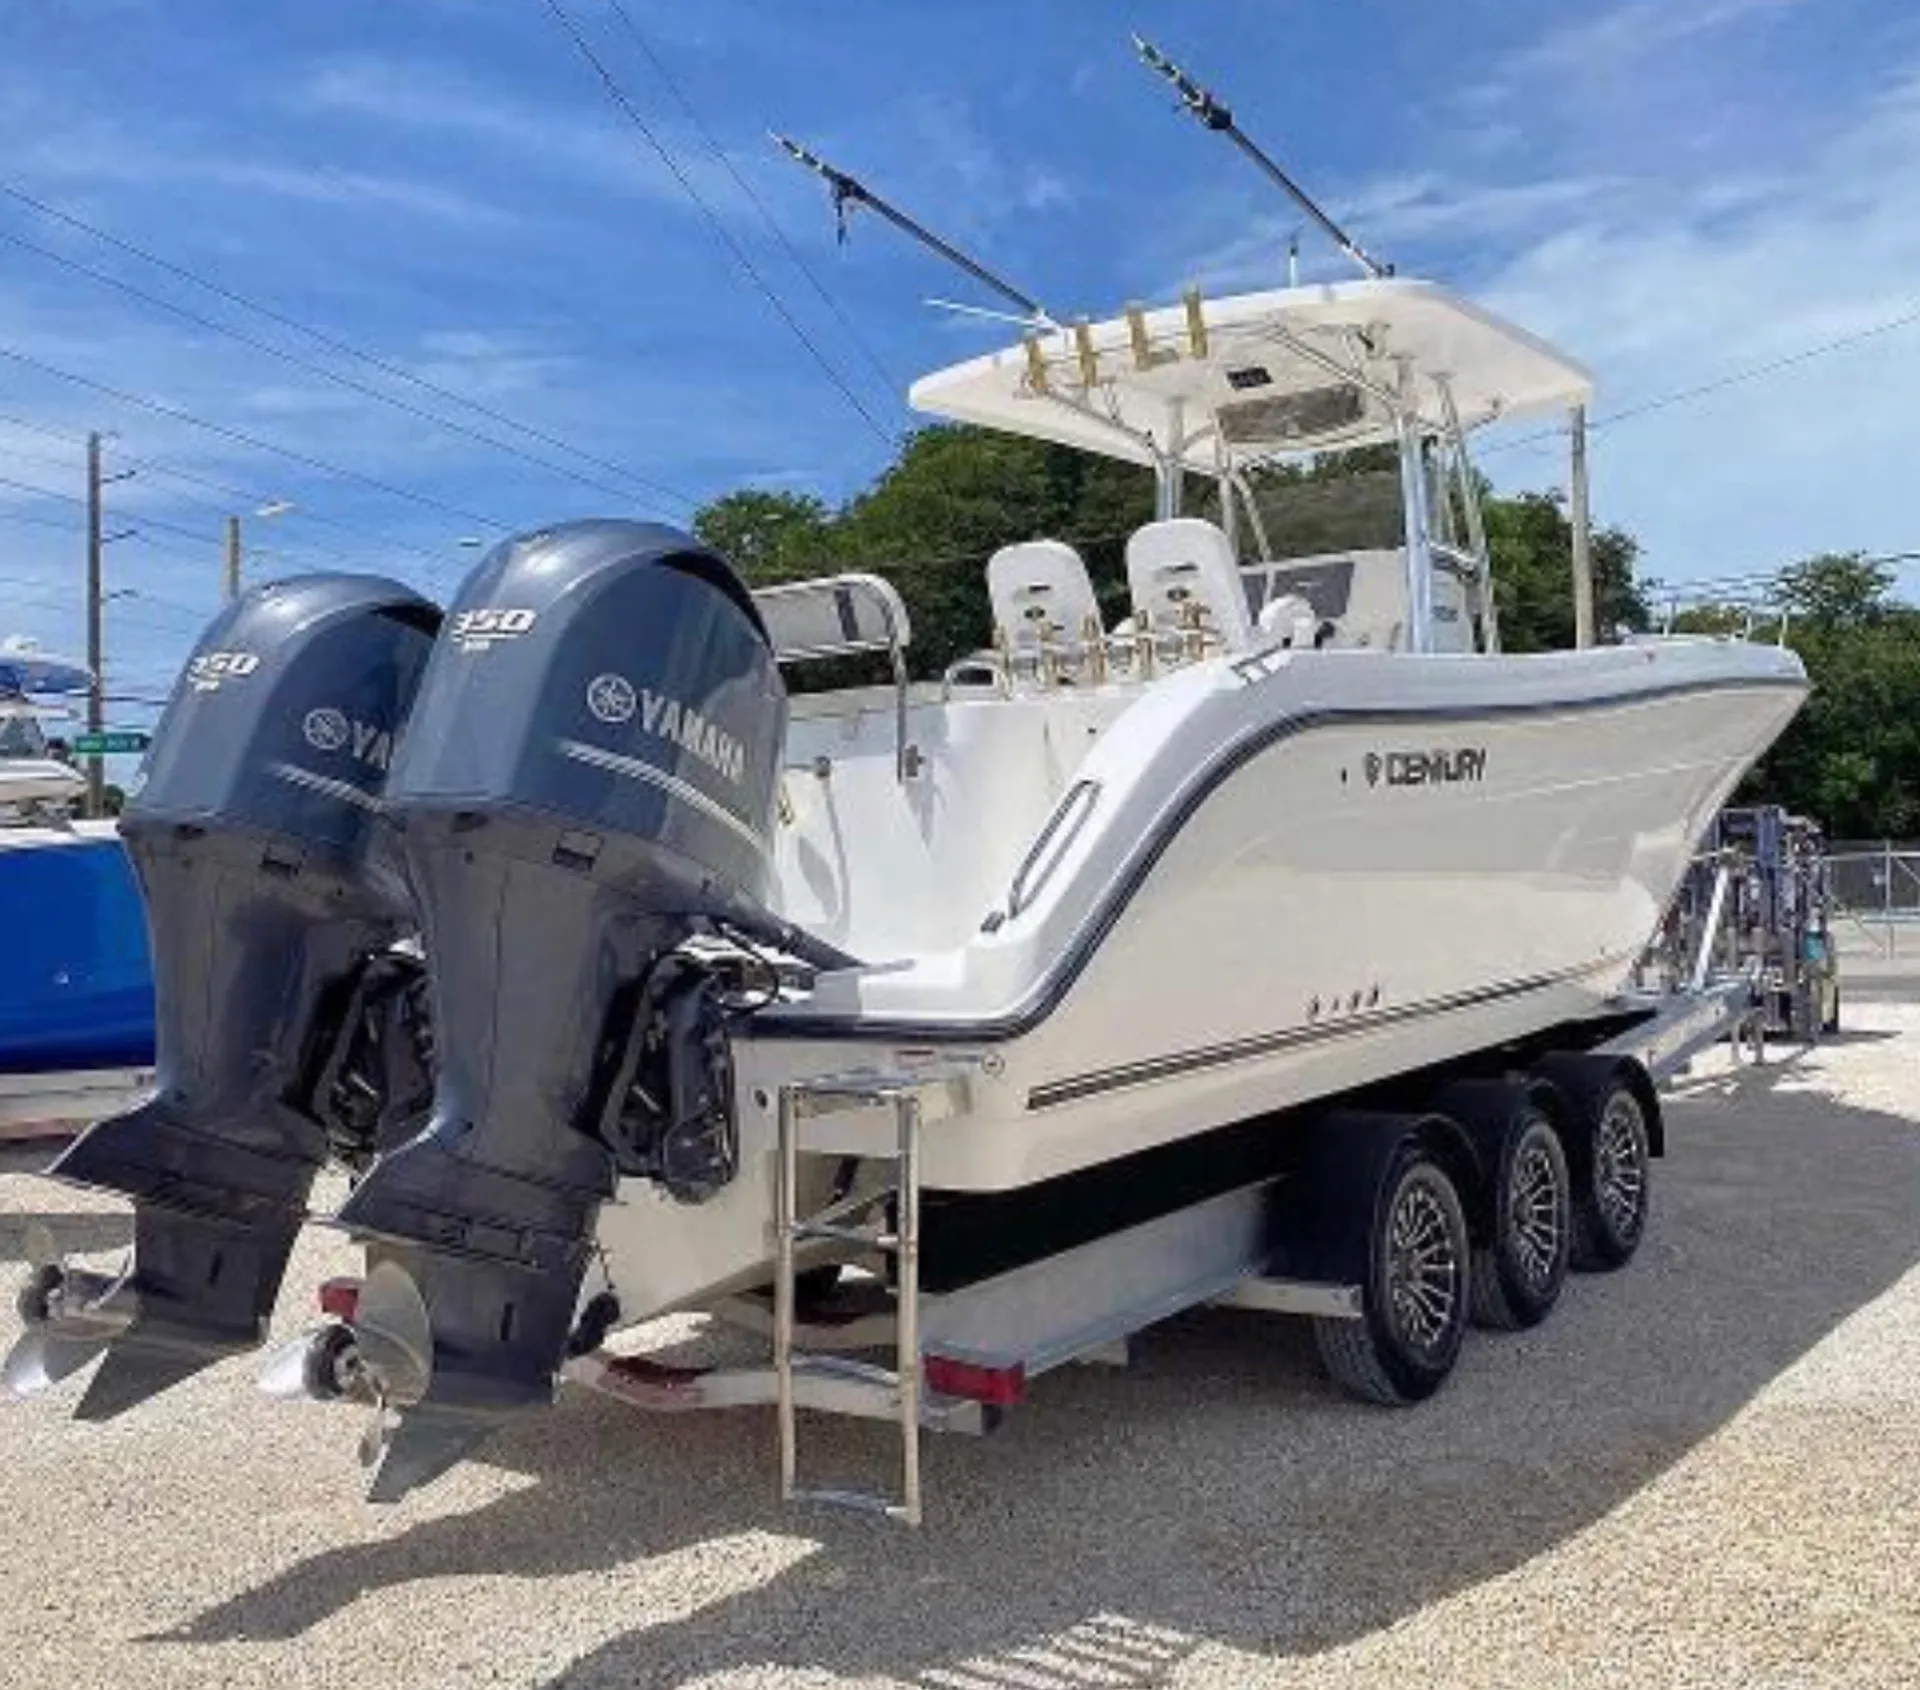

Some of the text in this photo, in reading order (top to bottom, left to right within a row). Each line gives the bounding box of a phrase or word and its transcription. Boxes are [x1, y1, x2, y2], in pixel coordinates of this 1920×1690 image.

[452, 608, 538, 642] 350
[352, 720, 392, 770] YA
[641, 687, 746, 785] YAMAHA
